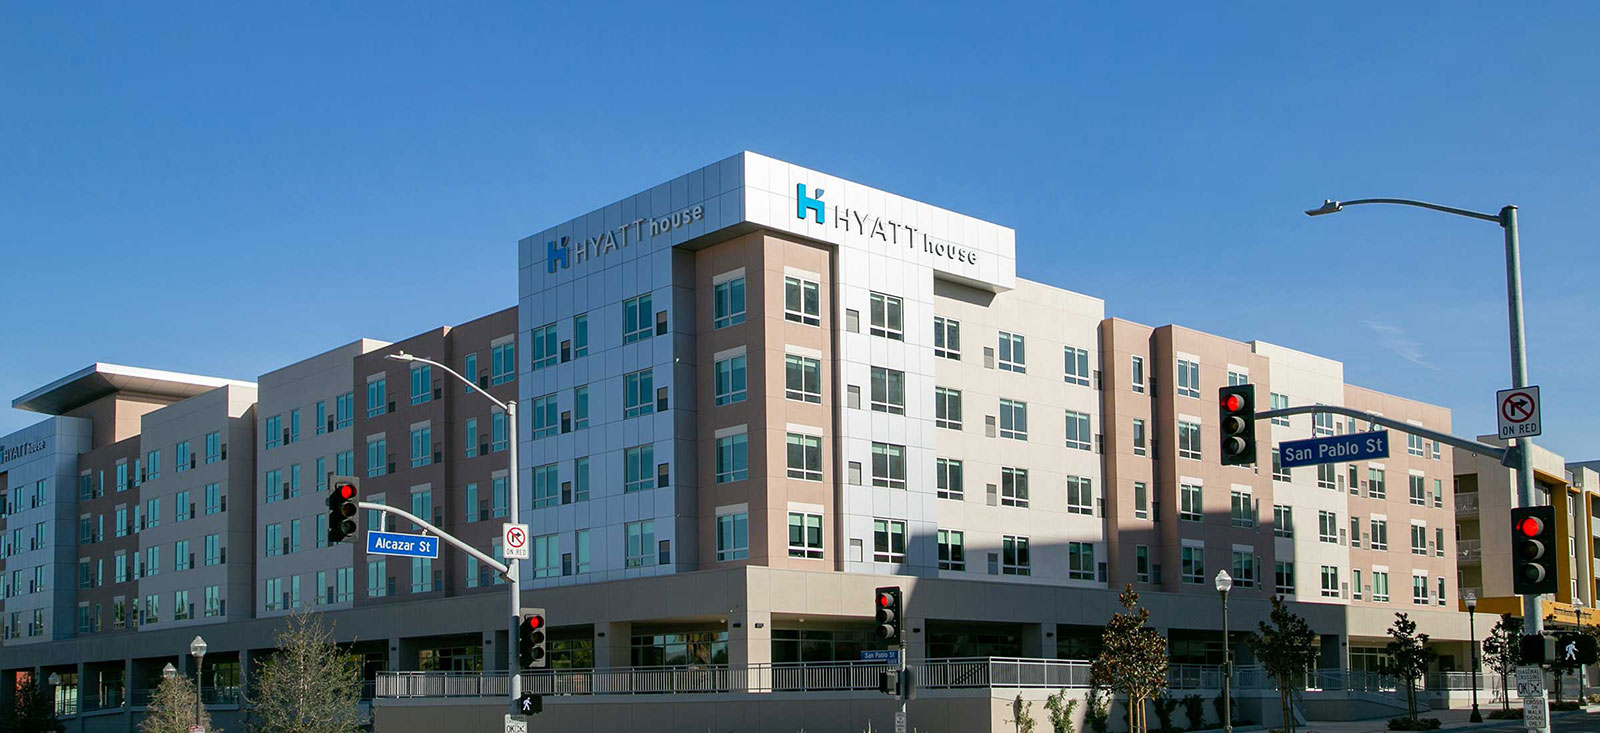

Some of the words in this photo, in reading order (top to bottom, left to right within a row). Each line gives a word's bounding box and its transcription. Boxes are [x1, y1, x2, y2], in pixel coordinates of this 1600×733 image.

[575, 218, 645, 264] HYATT
[650, 205, 704, 237] house
[834, 205, 919, 249] HYATT
[923, 233, 977, 265] house
[1502, 425, 1514, 436] ON
[1519, 423, 1537, 434] RED
[4, 442, 28, 463] HYATT
[1285, 447, 1312, 462] San
[1319, 442, 1359, 458] Pablo
[1366, 437, 1383, 453] St
[375, 537, 415, 552] Alcazar
[419, 540, 431, 553] St
[1518, 682, 1528, 694] OK
